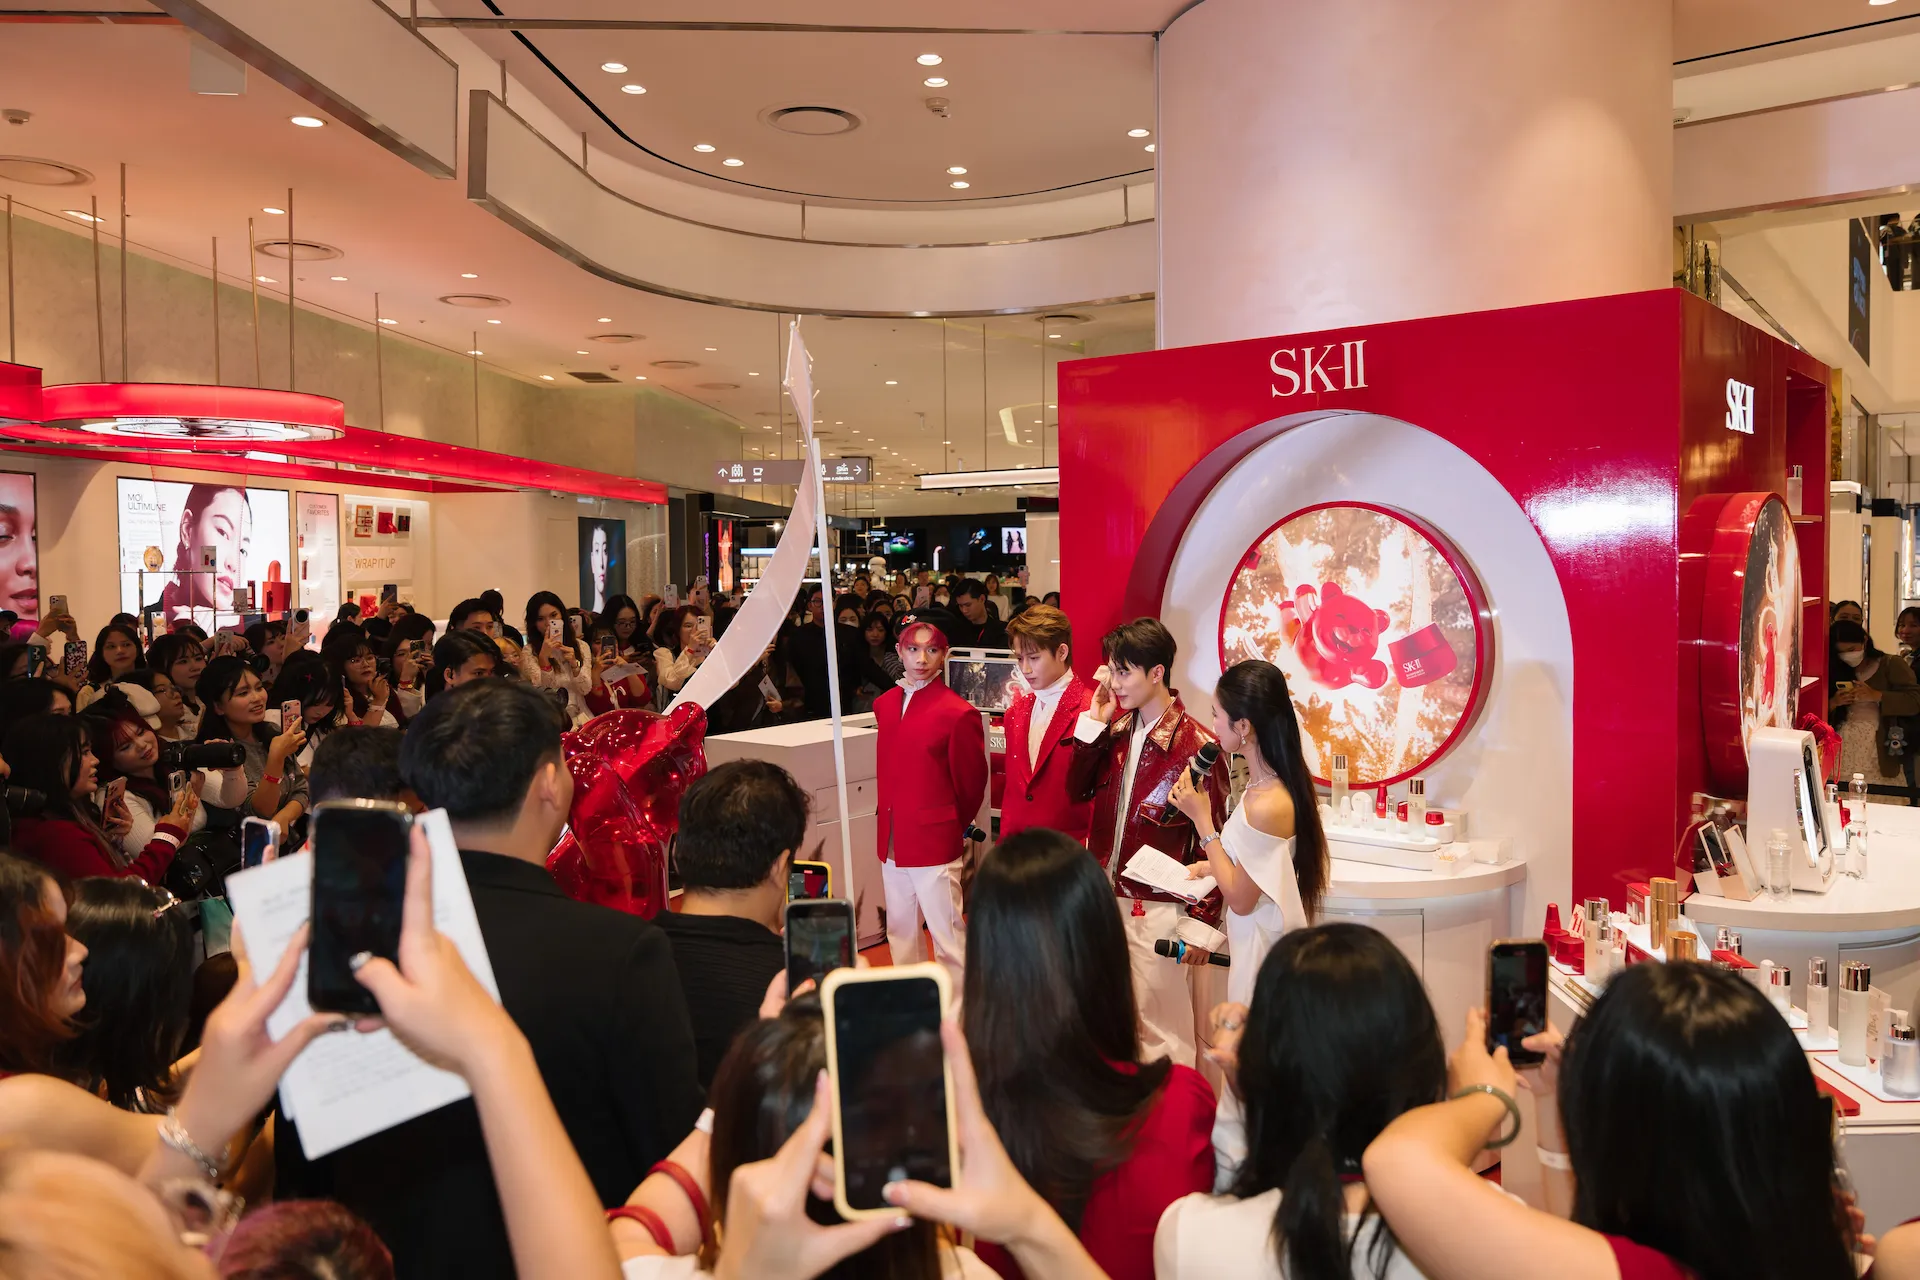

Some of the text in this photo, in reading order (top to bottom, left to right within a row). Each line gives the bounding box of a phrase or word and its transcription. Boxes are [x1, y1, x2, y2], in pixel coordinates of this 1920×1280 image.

[1270, 340, 1369, 398] SK-II
[306, 508, 329, 516] FAVORITES
[354, 558, 396, 569] WRAP IT UP
